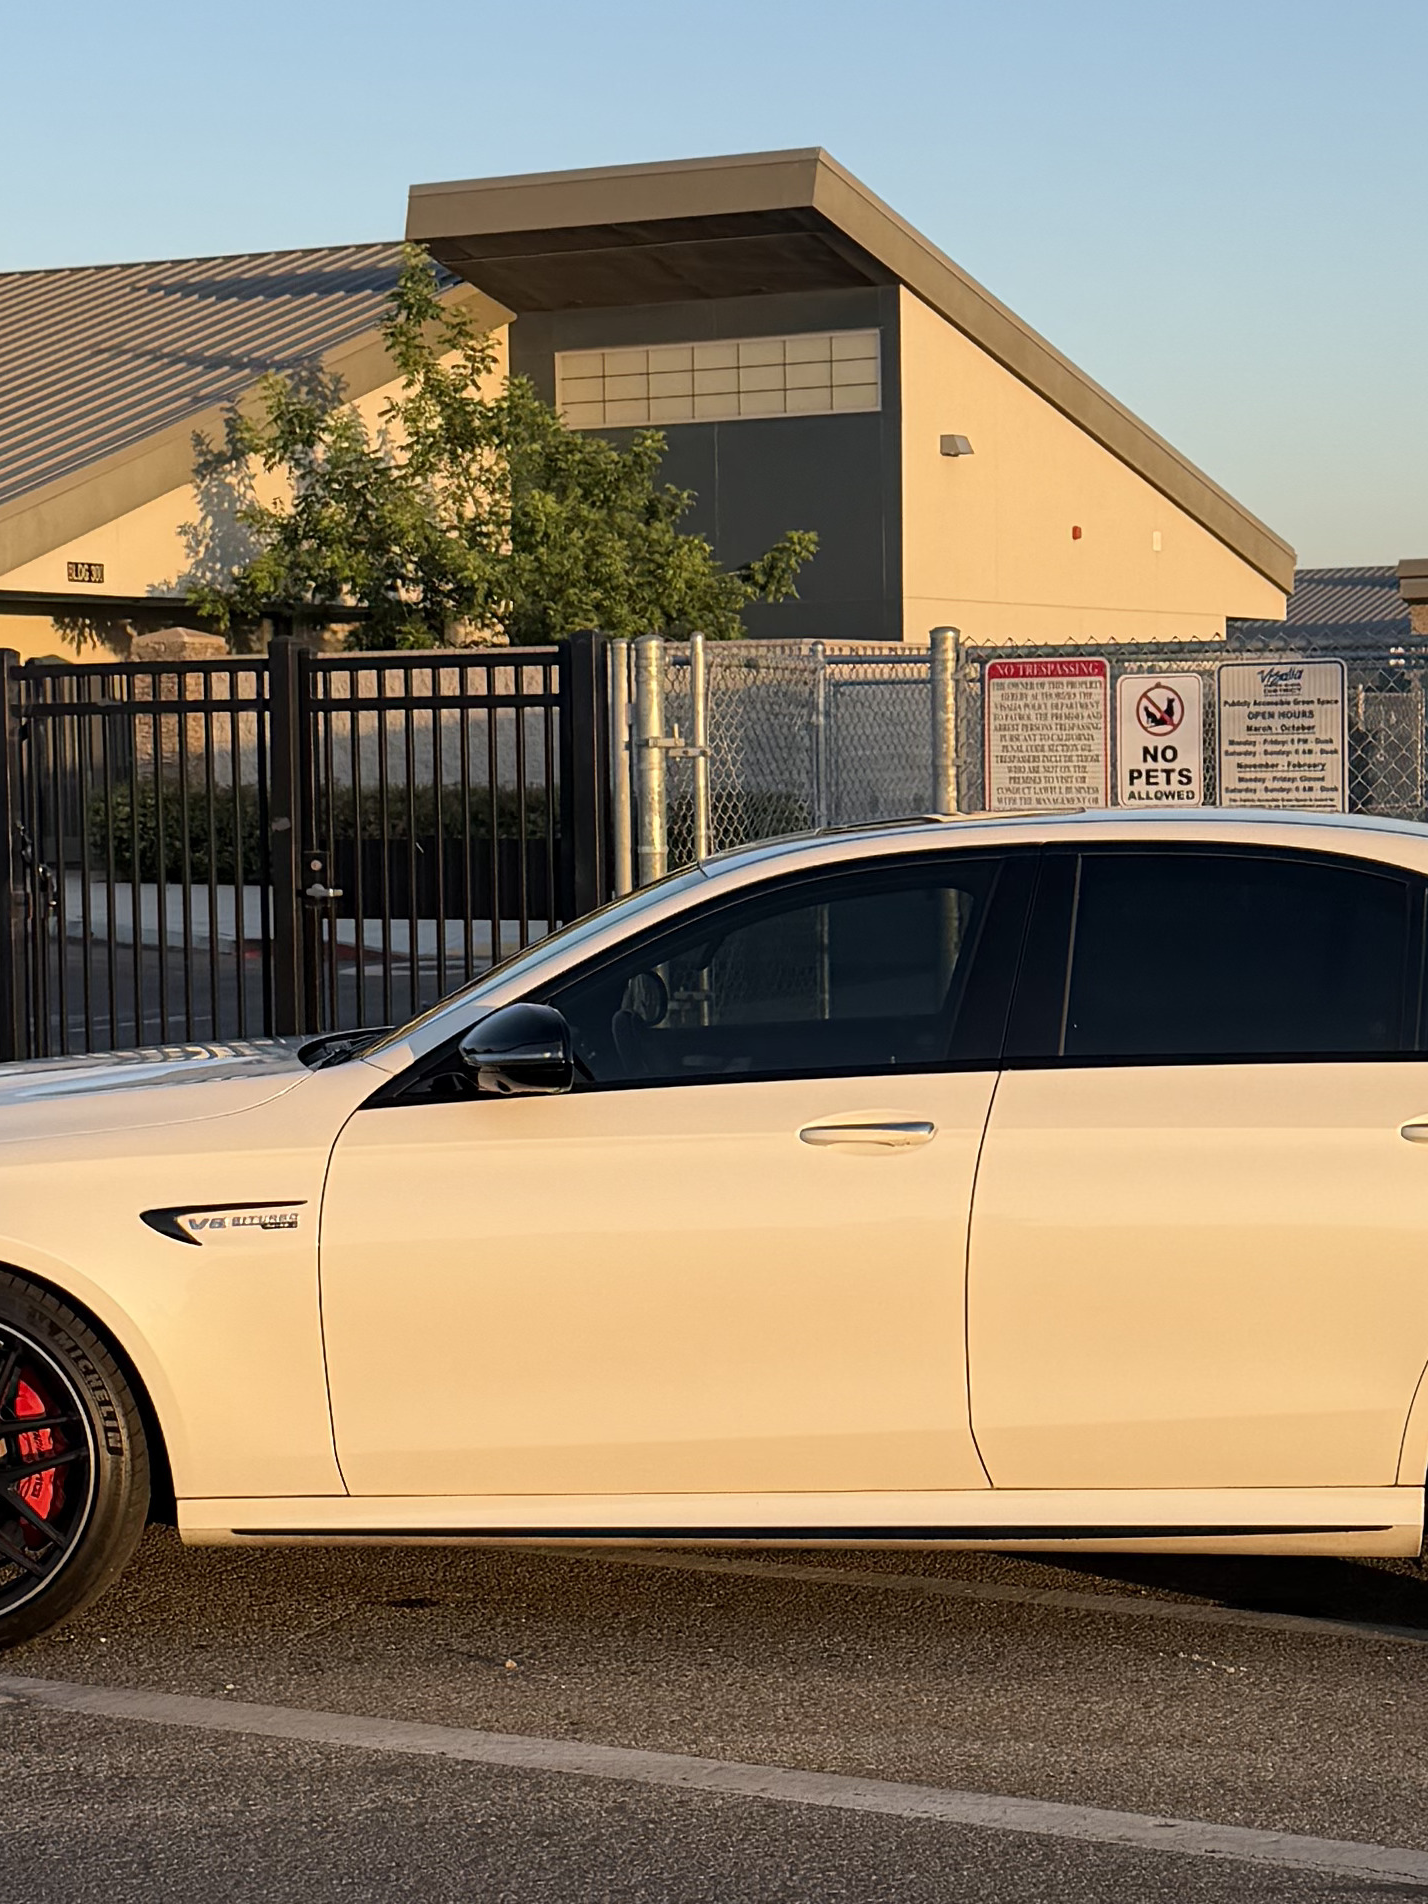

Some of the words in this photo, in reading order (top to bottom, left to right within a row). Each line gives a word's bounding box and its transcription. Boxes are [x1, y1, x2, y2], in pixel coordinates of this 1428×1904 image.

[68, 564, 89, 581] BLDG
[996, 664, 1014, 676] NO
[1017, 662, 1099, 676] TRESPASSING
[1247, 710, 1275, 720] OPEN
[1278, 710, 1315, 720] HOURS
[1246, 724, 1272, 732] March
[1280, 724, 1316, 732] October
[1142, 745, 1178, 763] NO
[1287, 760, 1327, 771] February
[1129, 767, 1193, 786] PETS
[1127, 789, 1196, 801] ALLOWED
[53, 1331, 124, 1452] MICHELIN
